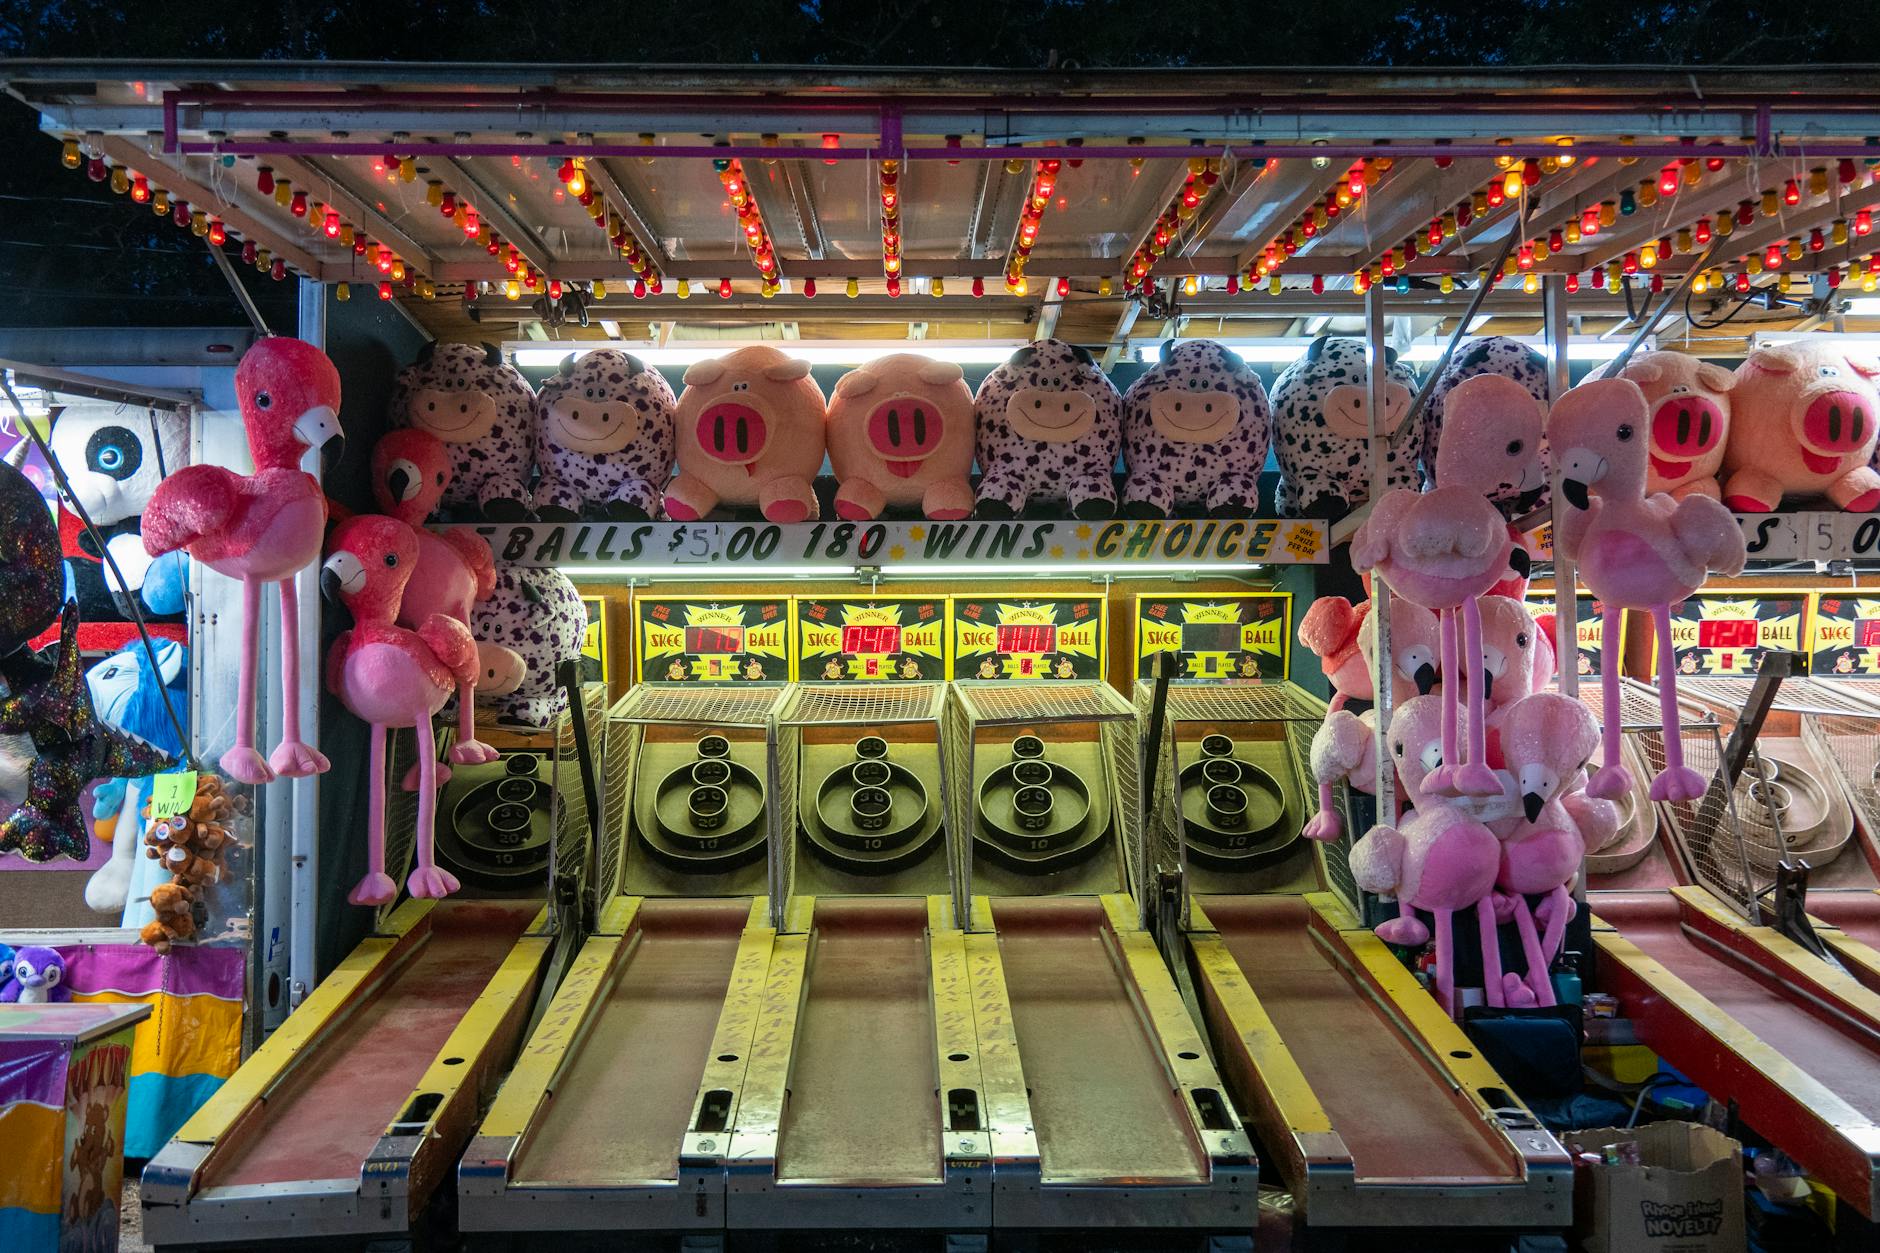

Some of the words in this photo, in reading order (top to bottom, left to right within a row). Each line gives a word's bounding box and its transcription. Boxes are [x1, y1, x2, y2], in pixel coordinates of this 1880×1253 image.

[502, 525, 653, 561] BALLS
[803, 523, 887, 559] 180
[923, 523, 1054, 559] WINS
[1095, 522, 1278, 559] CHOICE
[1288, 541, 1301, 551] PER
[1302, 546, 1315, 555] DAY
[697, 613, 733, 623] WINNER
[854, 611, 889, 623] WINNER
[1009, 611, 1044, 622] WINNER
[1195, 609, 1228, 620] WINNER
[962, 632, 993, 646] SKEE
[1060, 632, 1090, 645] BALL
[1148, 631, 1178, 644] SKEE
[1245, 631, 1275, 644] BALL
[1579, 628, 1602, 641] BAL
[1671, 628, 1695, 641] KEE
[1762, 627, 1792, 640] BALL
[1820, 627, 1851, 640] SKEE
[650, 633, 682, 647] SKEE
[749, 633, 779, 646] BALL
[807, 633, 839, 647] SKEE
[905, 633, 935, 646] BALL
[171, 785, 178, 799] 1
[158, 801, 184, 814] WIN
[699, 818, 717, 828] 20
[863, 818, 882, 828] 20
[1026, 818, 1045, 828] 20
[1220, 816, 1241, 825] 20
[499, 833, 519, 844] 20
[865, 839, 881, 849] 10
[1031, 839, 1048, 849] 10
[1227, 836, 1247, 847] 10
[700, 840, 717, 849] 10
[496, 854, 513, 864] 10
[1645, 1217, 1722, 1237] NOVELTY
